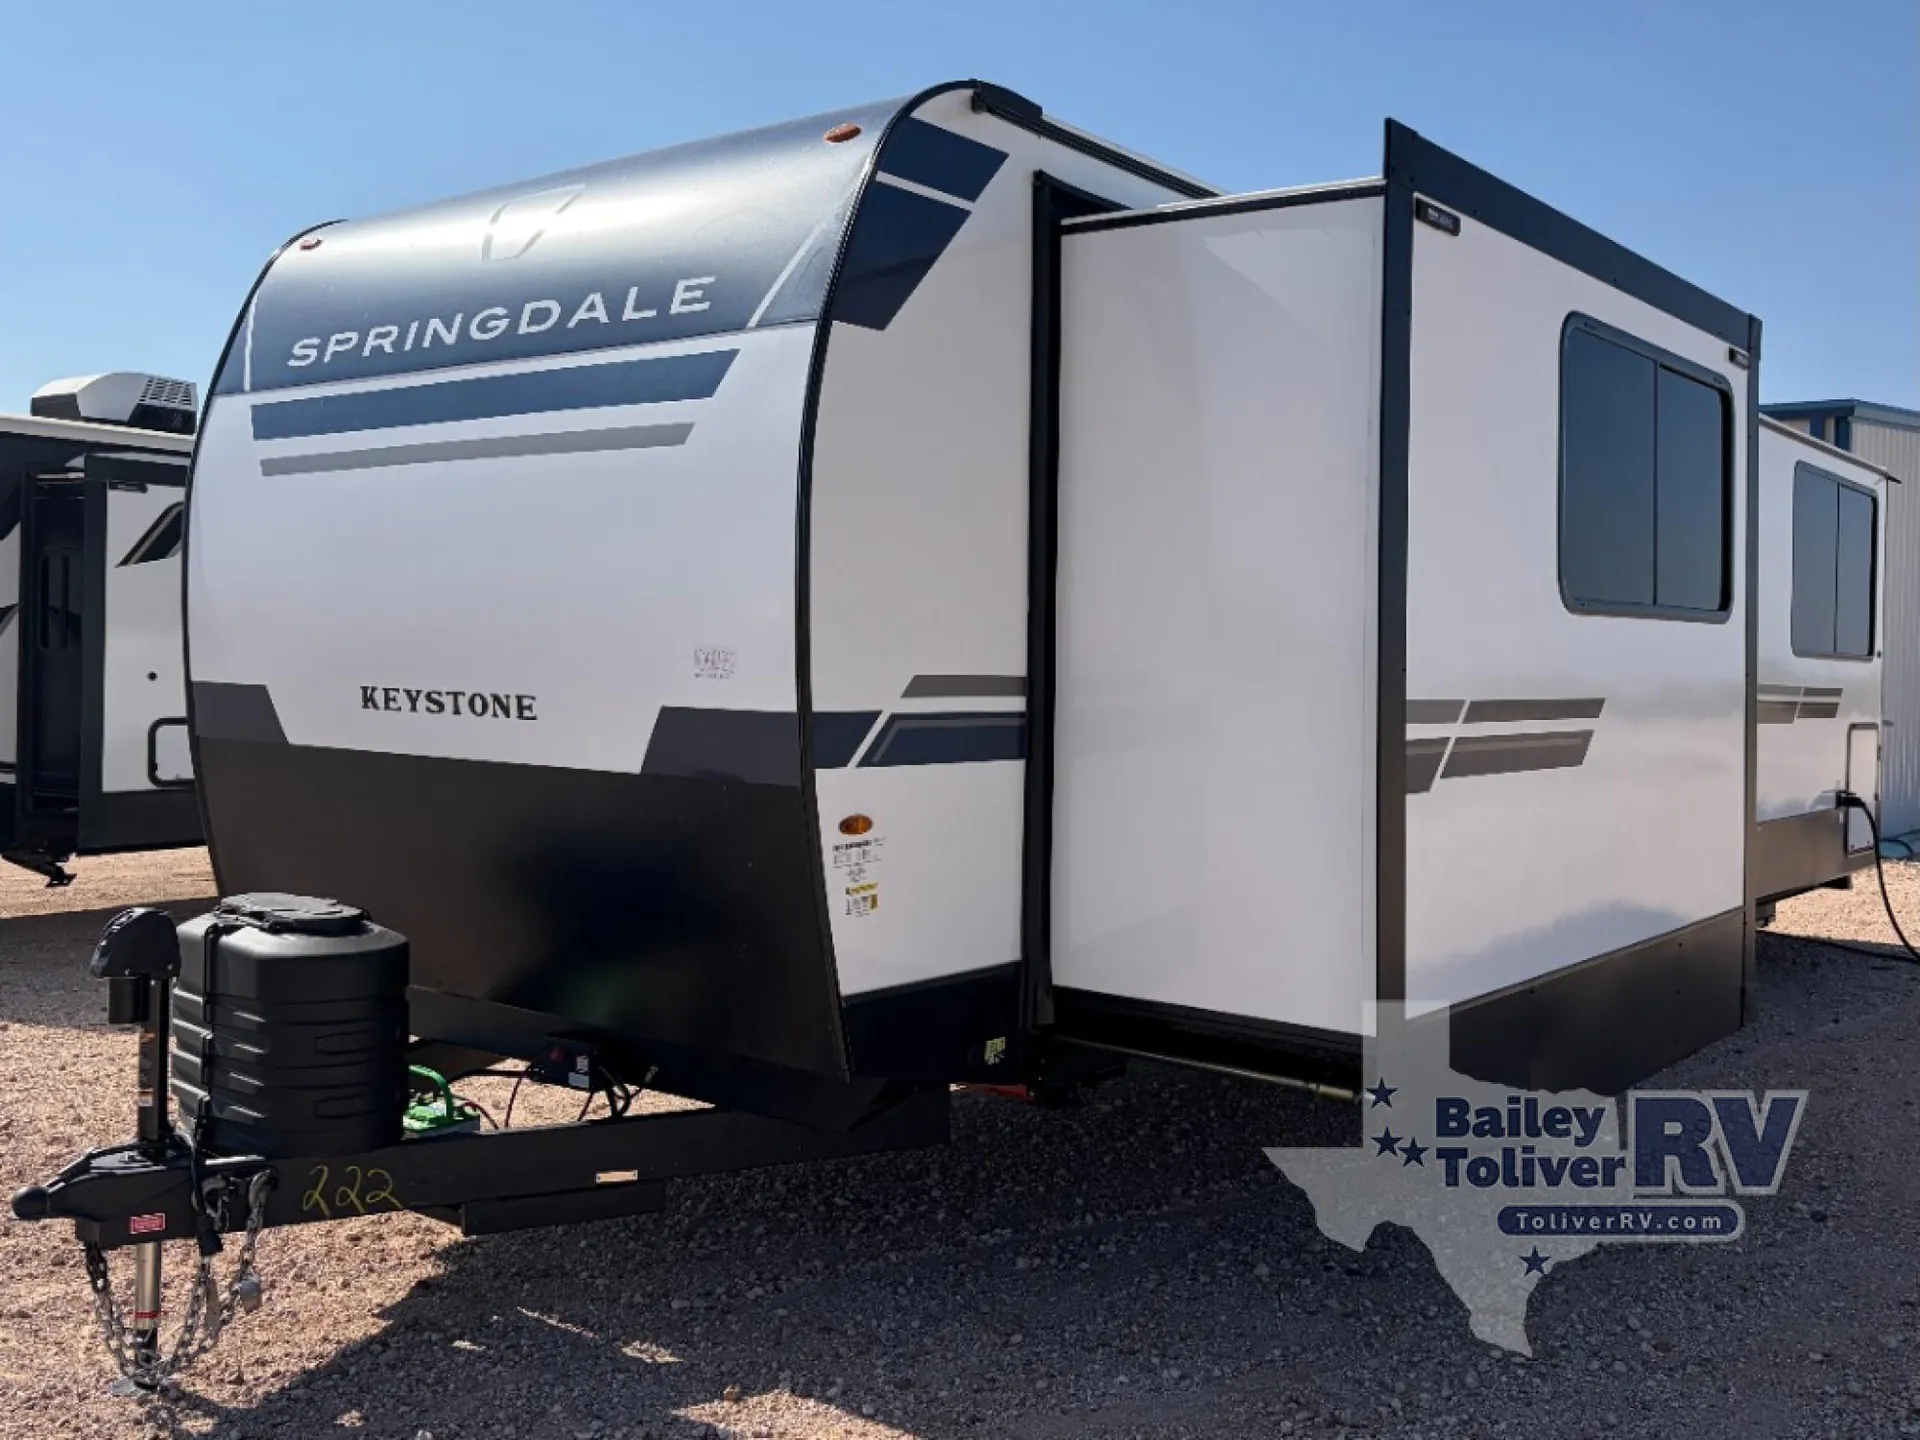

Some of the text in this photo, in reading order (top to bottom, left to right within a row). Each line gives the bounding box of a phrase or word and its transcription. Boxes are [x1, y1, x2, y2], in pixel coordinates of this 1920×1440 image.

[286, 275, 717, 368] SPRINGDALE
[359, 685, 539, 721] KEYSTONE
[302, 1164, 404, 1218] 222
